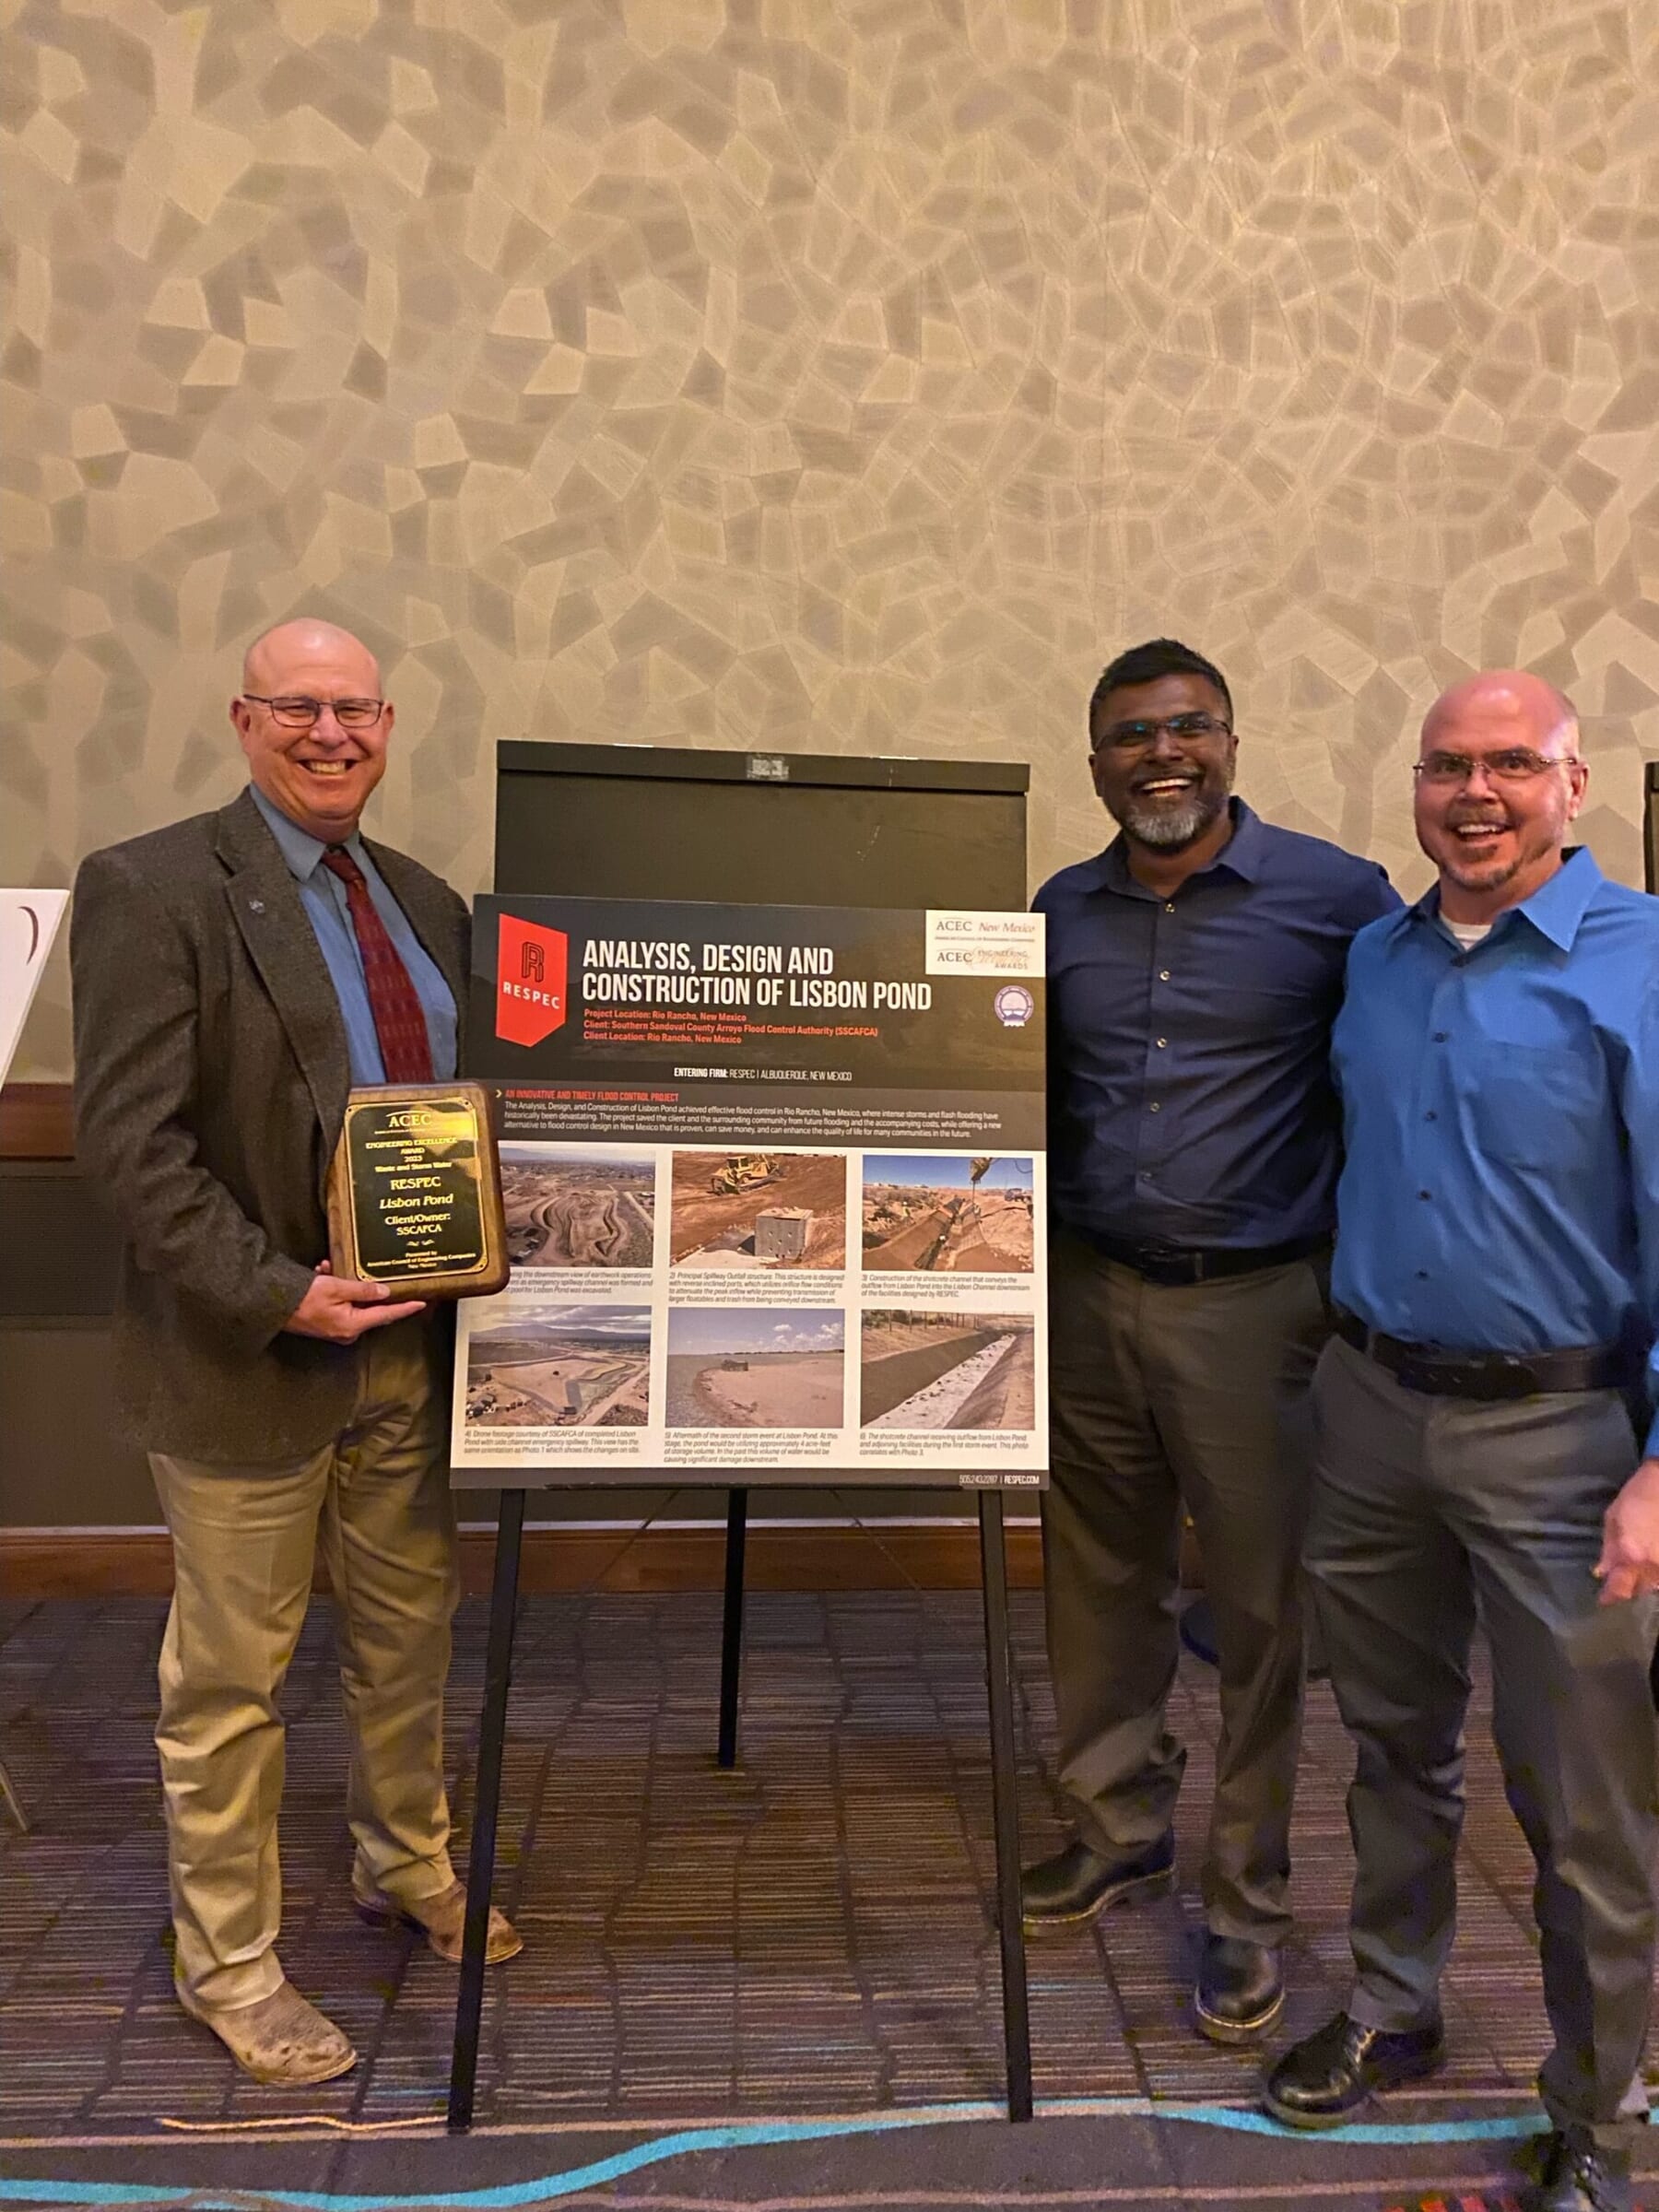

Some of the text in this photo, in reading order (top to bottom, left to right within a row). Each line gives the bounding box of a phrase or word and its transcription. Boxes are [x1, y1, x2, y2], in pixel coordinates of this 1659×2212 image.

[936, 921, 1035, 933] ACEC New Mexico
[582, 940, 834, 975] ANALYSIS, DESIGN AND
[936, 951, 972, 962] ACEC
[994, 962, 1029, 971] AWARDS
[502, 981, 560, 1010] RESPEC
[582, 972, 932, 1011] CONSTRUCTION OF LISBON POND
[584, 1008, 747, 1022] Project Location: Rio Rancho, New Mexico
[583, 1020, 878, 1038] Client: Southern Sandoval County Arroyo Flood Control Authority (SSCAFCA)
[583, 1031, 741, 1044] Client Location: Rio Rancho, New Mexico
[674, 1067, 852, 1081] ENTERING FIRM: RESPEC ALBUQUERQUE, NEW MEXICO
[505, 1089, 678, 1102] AN INNOVATIVE AND TIMELY FLOOD CONTROL PROJECT
[505, 1100, 517, 1110] The
[519, 1101, 547, 1112] Analysis,
[548, 1101, 571, 1112] Design,
[573, 1102, 586, 1111] and
[587, 1102, 629, 1112] Construction
[629, 1103, 637, 1112] of
[638, 1104, 659, 1112] Lisbon
[661, 1104, 677, 1112] Pond
[678, 1104, 707, 1113] achieved
[708, 1105, 735, 1113] effective
[736, 1106, 752, 1114] flood
[754, 1106, 776, 1114] control
[784, 1107, 794, 1115] Rio
[795, 1107, 821, 1118] Rancho,
[822, 1108, 836, 1116] New
[837, 1108, 861, 1118] Mexico,
[862, 1109, 880, 1117] where
[882, 1109, 904, 1117] intense
[906, 1110, 926, 1118] storms
[928, 1110, 940, 1118] and
[957, 1111, 982, 1121] flooding
[388, 1113, 432, 1128] ACEC
[504, 1112, 540, 1122] historically
[559, 1112, 597, 1123] devastating.
[612, 1113, 635, 1124] project
[656, 1114, 667, 1123] the
[700, 1115, 712, 1124] the
[712, 1115, 750, 1126] surrounding
[752, 1116, 787, 1126] community
[788, 1117, 803, 1125] from
[804, 1117, 822, 1125] future
[824, 1118, 850, 1128] flooding
[851, 1118, 863, 1126] and
[876, 1119, 921, 1129] accompanying
[922, 1120, 940, 1130] costs,
[941, 1120, 957, 1128] while
[958, 1121, 982, 1131] offering
[390, 1176, 442, 1191] RESPEC
[379, 1194, 453, 1209] Lisbon Pond
[384, 1213, 451, 1225] Client/Owner:
[396, 1224, 442, 1236] SSCAFCA
[1004, 1475, 1040, 1484] RESPEC.COM
